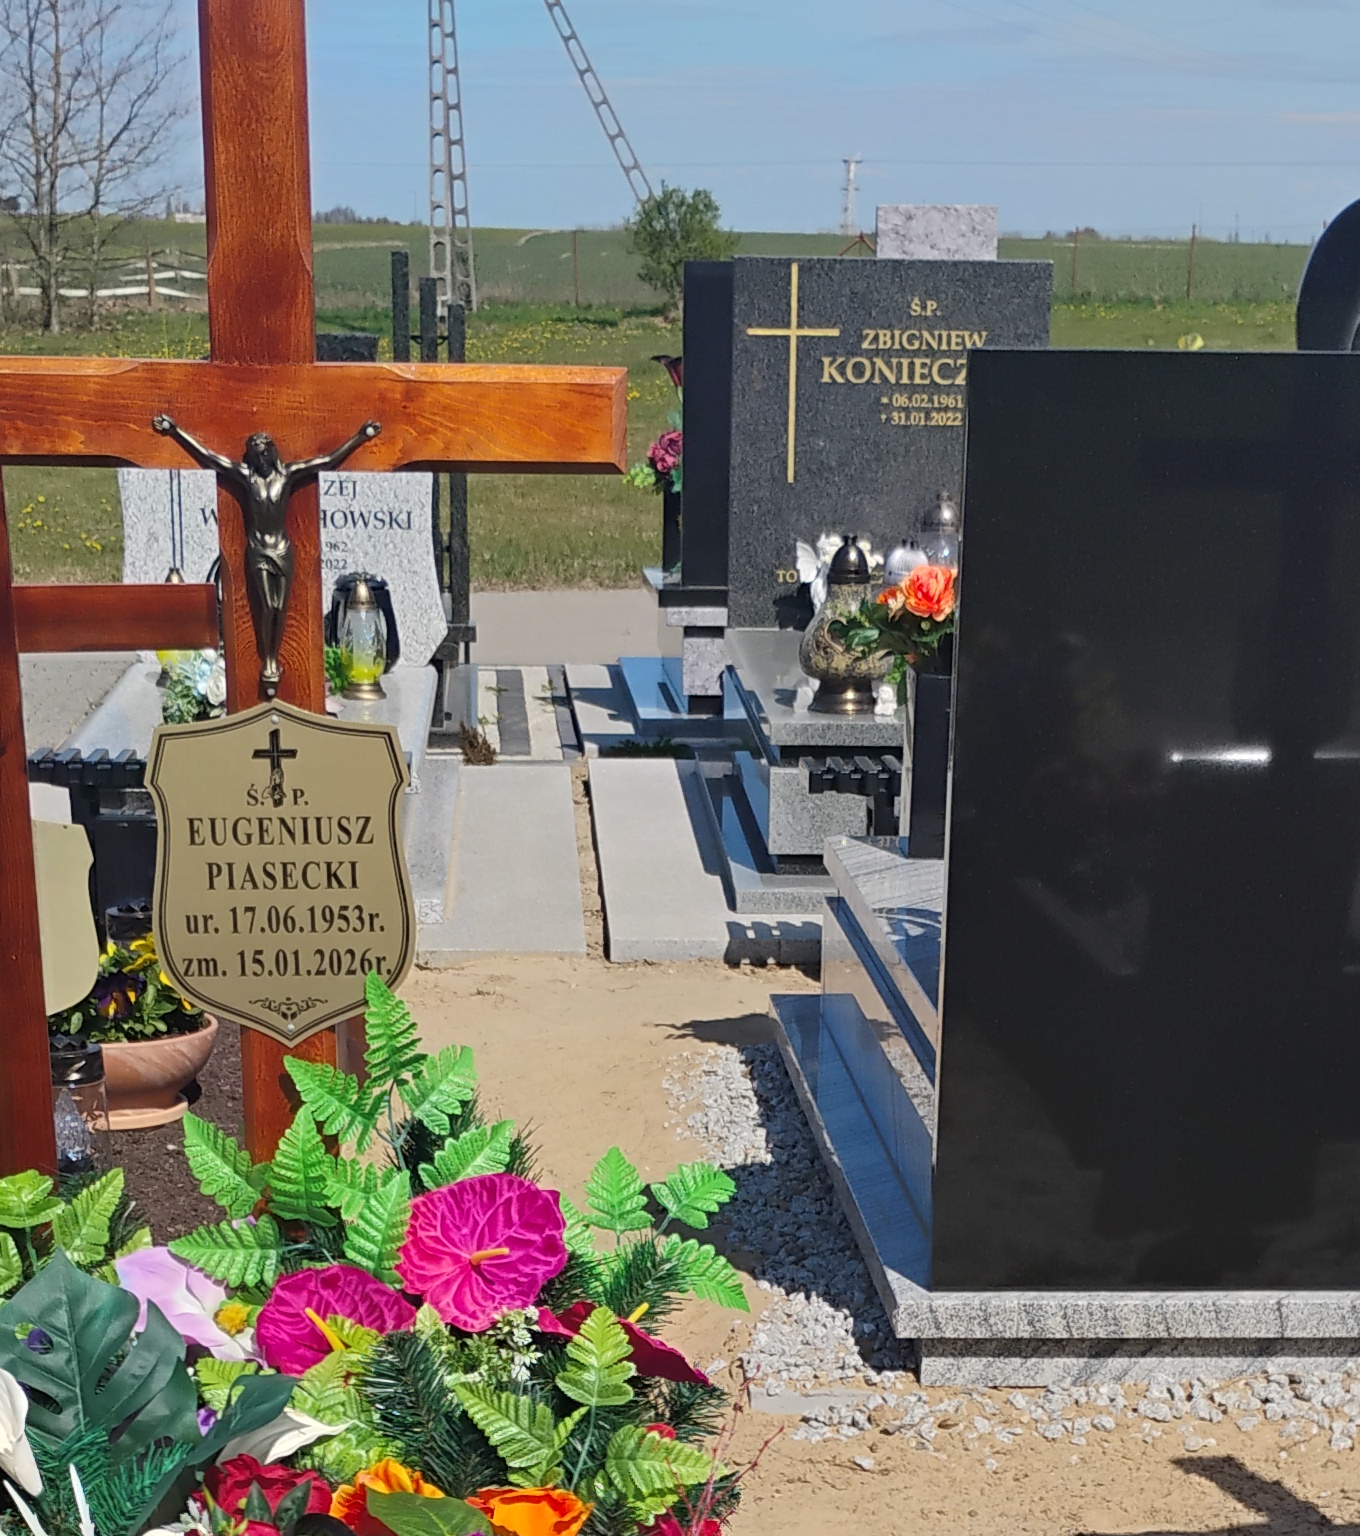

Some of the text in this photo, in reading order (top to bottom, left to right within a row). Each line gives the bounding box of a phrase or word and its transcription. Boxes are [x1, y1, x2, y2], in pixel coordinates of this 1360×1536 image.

[910, 296, 940, 316] Ś.P.
[861, 329, 988, 350] ZBIGNIEW
[892, 394, 965, 409] 06.02.1961
[890, 411, 964, 426] 31.01.2022
[246, 784, 309, 807] Ś. P.
[186, 815, 375, 847] EUGENIUSZ
[205, 860, 361, 892] PIASECKI
[185, 904, 386, 935] ur. 17.06.1953r.
[182, 947, 392, 978] zm. 15.01.2026r.
